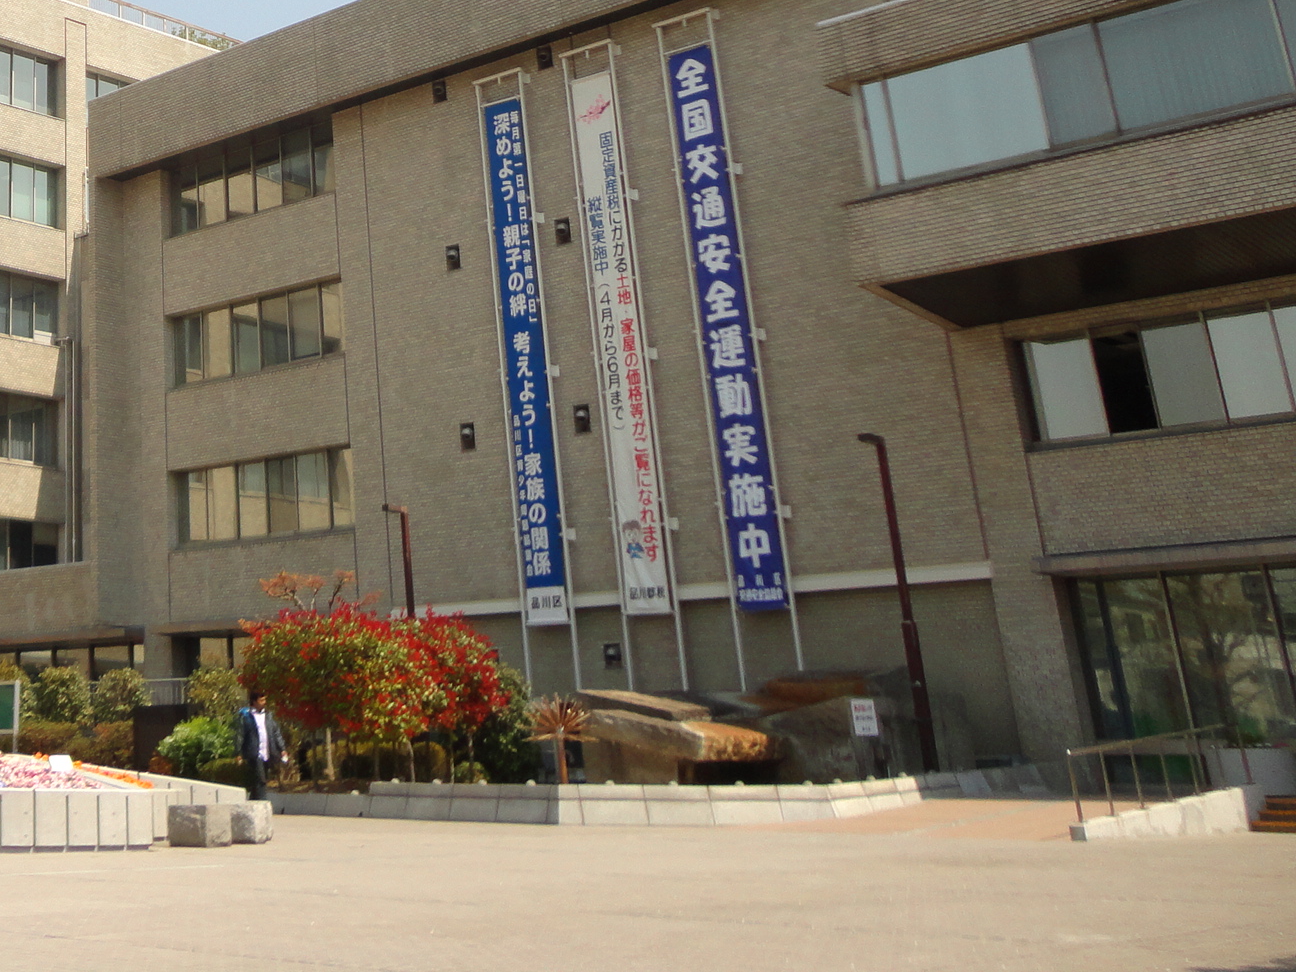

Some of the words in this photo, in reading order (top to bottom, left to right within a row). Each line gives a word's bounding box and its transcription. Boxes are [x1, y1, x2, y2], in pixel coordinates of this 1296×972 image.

[676, 57, 771, 568] 全国交通安全運動実施中
[531, 595, 563, 609] 品川区
